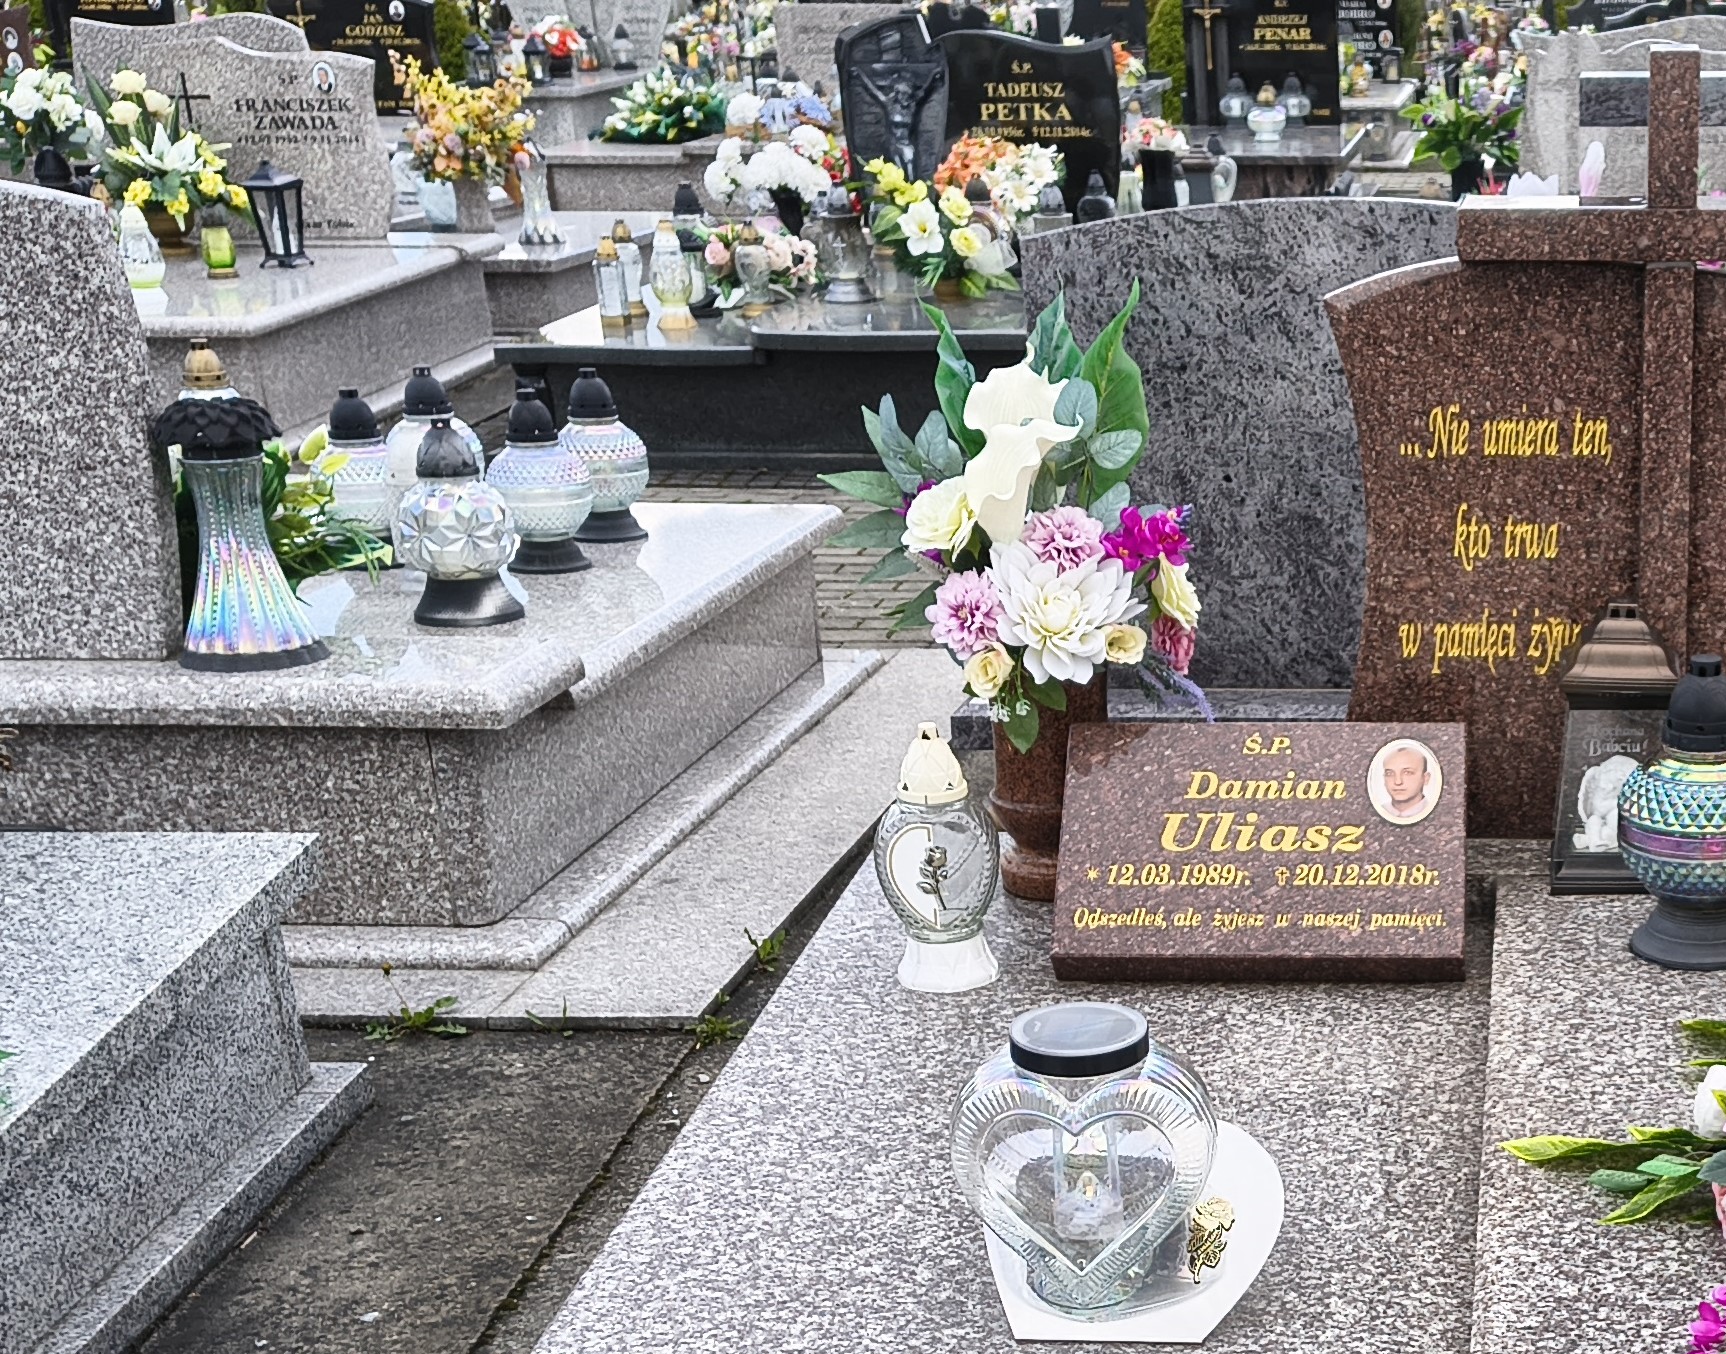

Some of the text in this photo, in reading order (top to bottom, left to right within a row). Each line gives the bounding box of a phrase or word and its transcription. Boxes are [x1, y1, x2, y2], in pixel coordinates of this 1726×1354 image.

[1254, 27, 1312, 40] PENAR
[983, 82, 1065, 98] TADEUSZ
[234, 97, 352, 113] FRANCISZEK
[979, 103, 1073, 121] PETKA
[254, 115, 338, 130] ZAWADA
[1482, 404, 1560, 457] umiera
[1572, 407, 1613, 466] ten,
[1454, 502, 1560, 571] kto trwa
[1399, 620, 1423, 658] w
[1431, 607, 1517, 676] pamięci
[1242, 732, 1293, 755] Ś.P.
[1582, 738, 1648, 757] Babciu!
[1184, 770, 1347, 800] Damian
[1159, 812, 1366, 853] Uliasz
[1073, 906, 1448, 932] Odszedłeś, ale żyjesz w naszej pamięci.
